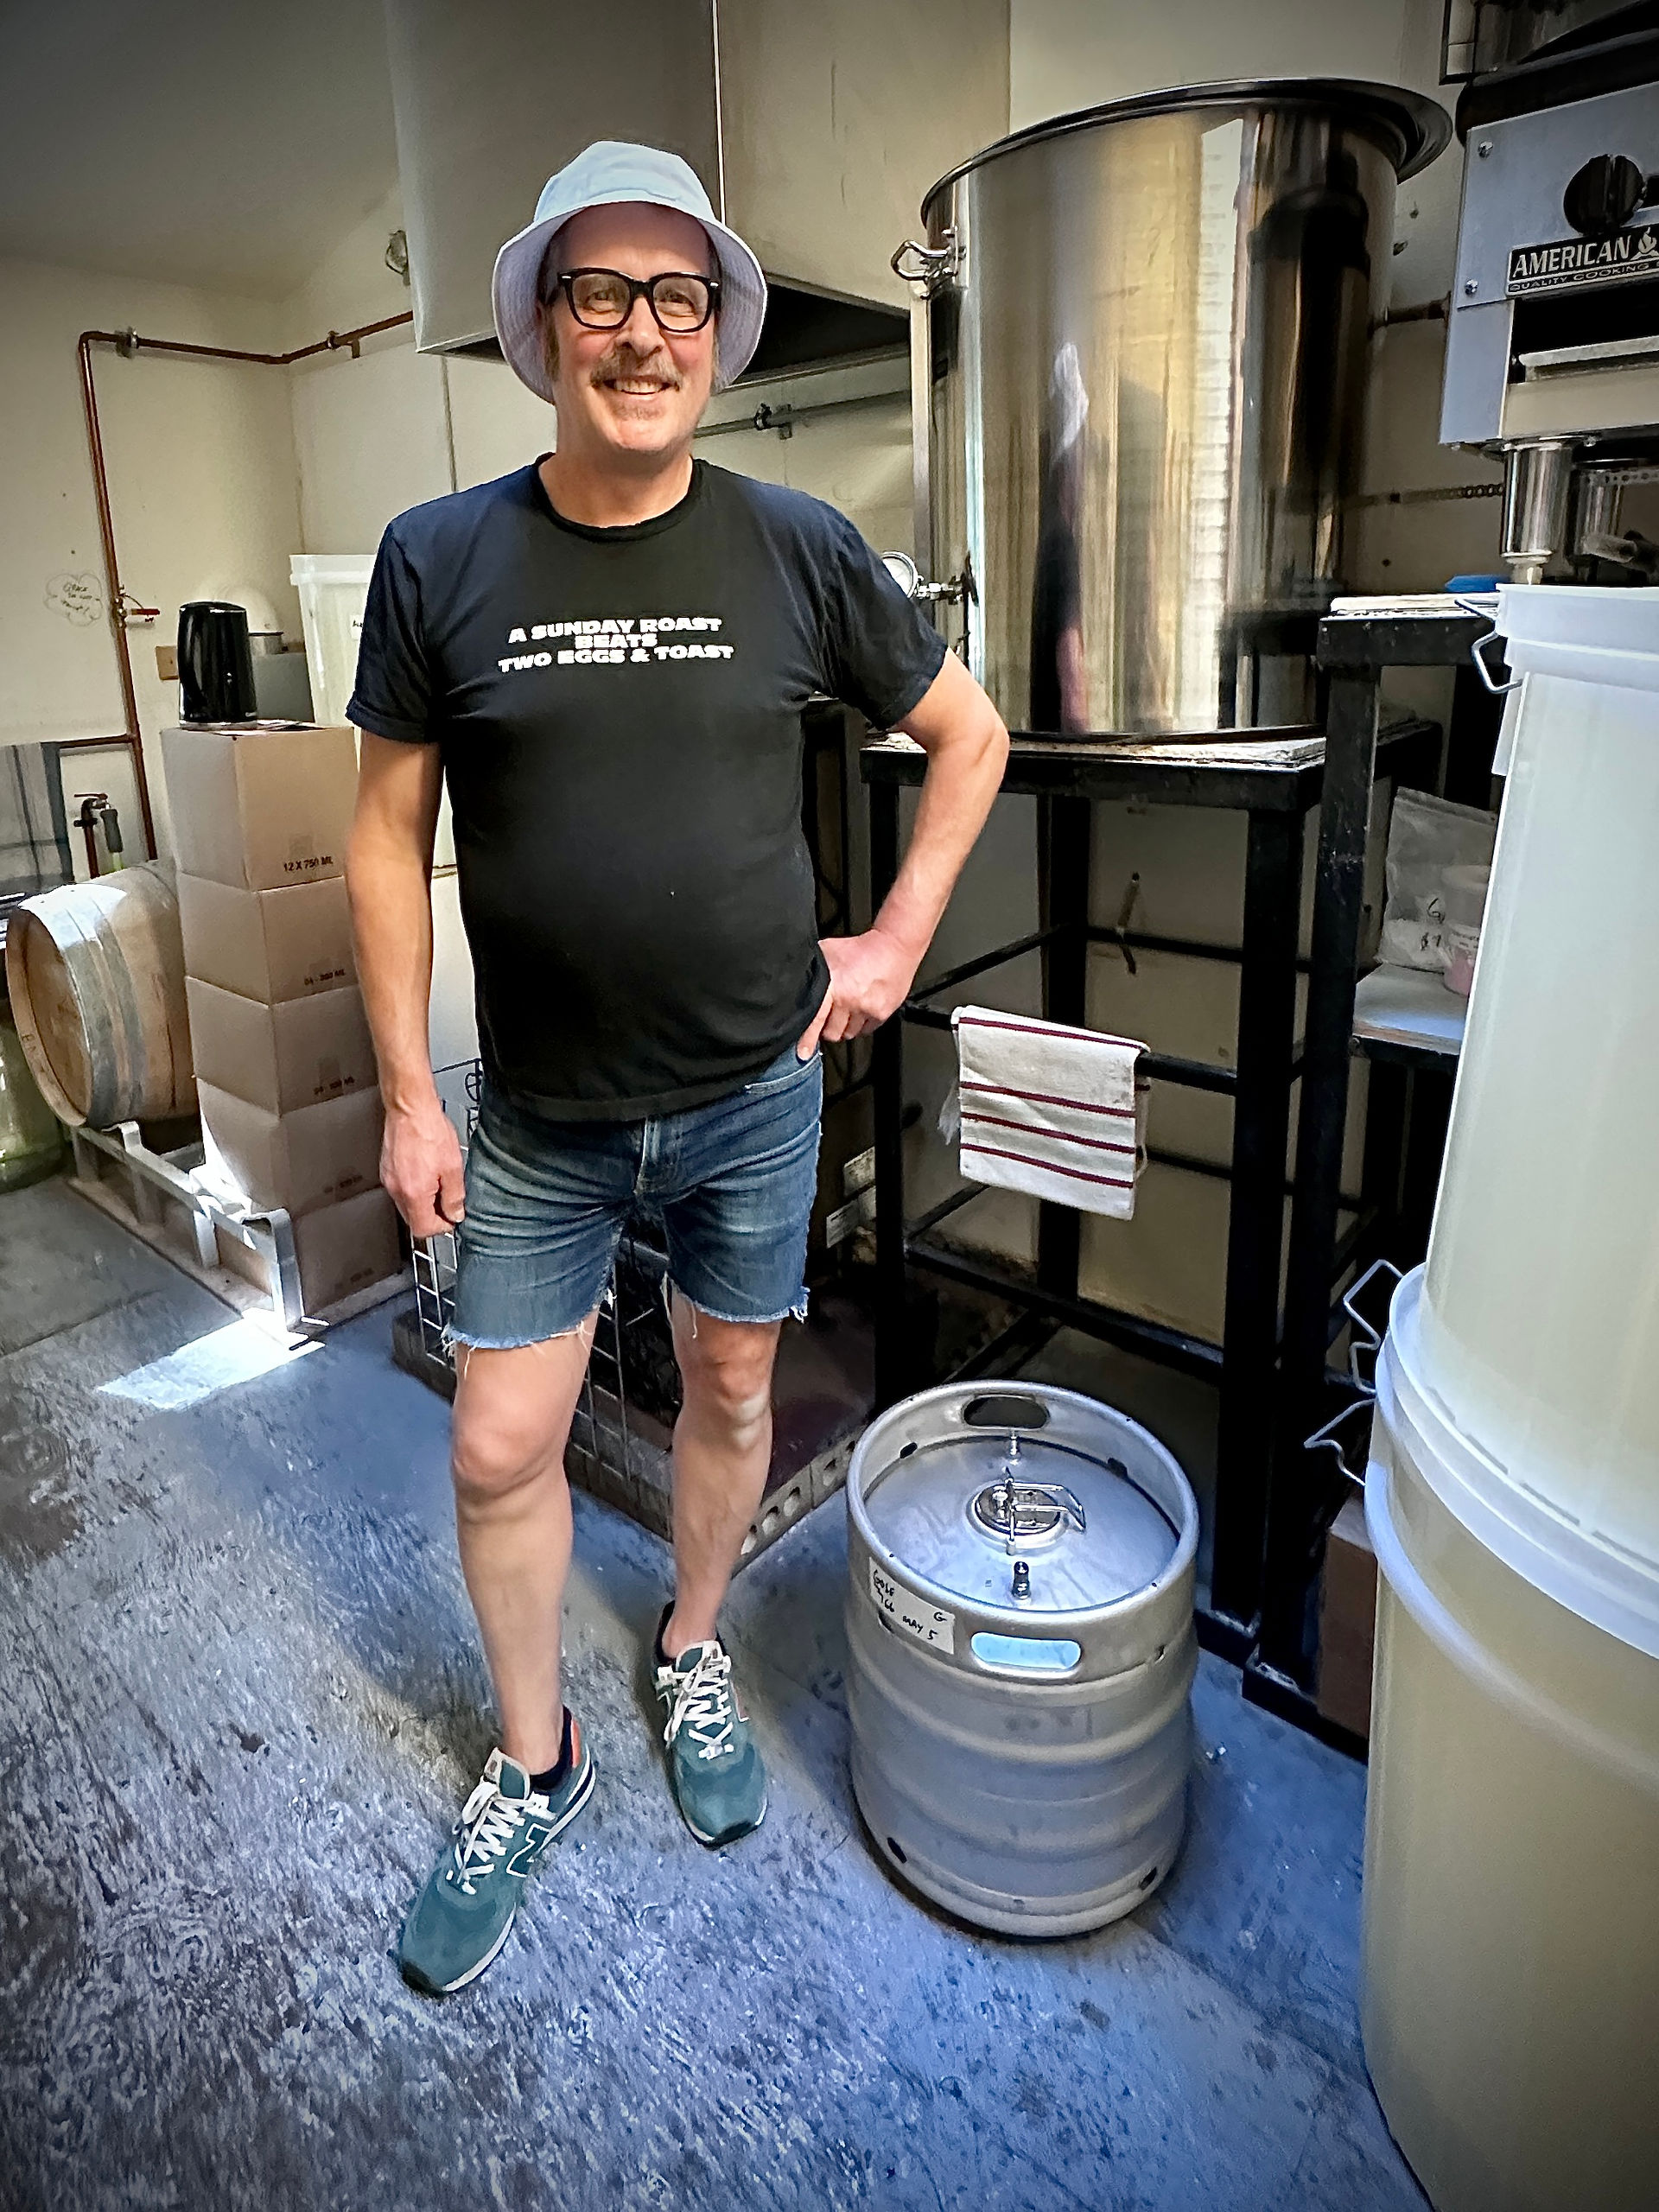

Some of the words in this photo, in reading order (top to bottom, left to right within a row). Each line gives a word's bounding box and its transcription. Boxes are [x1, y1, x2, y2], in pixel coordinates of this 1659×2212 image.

[1512, 235, 1631, 278] AMERICAN
[1510, 276, 1567, 291] QUALITY
[1573, 262, 1649, 281] COOKING
[508, 627, 527, 644] A
[531, 620, 635, 640] SUNDAY
[639, 617, 722, 633] ROAST
[575, 632, 658, 649] BEATS
[498, 652, 552, 673] TWO
[557, 649, 626, 664] EGGS
[630, 649, 650, 663] &
[654, 645, 734, 660] TOAST
[283, 862, 295, 872] 12
[303, 856, 320, 869] 750
